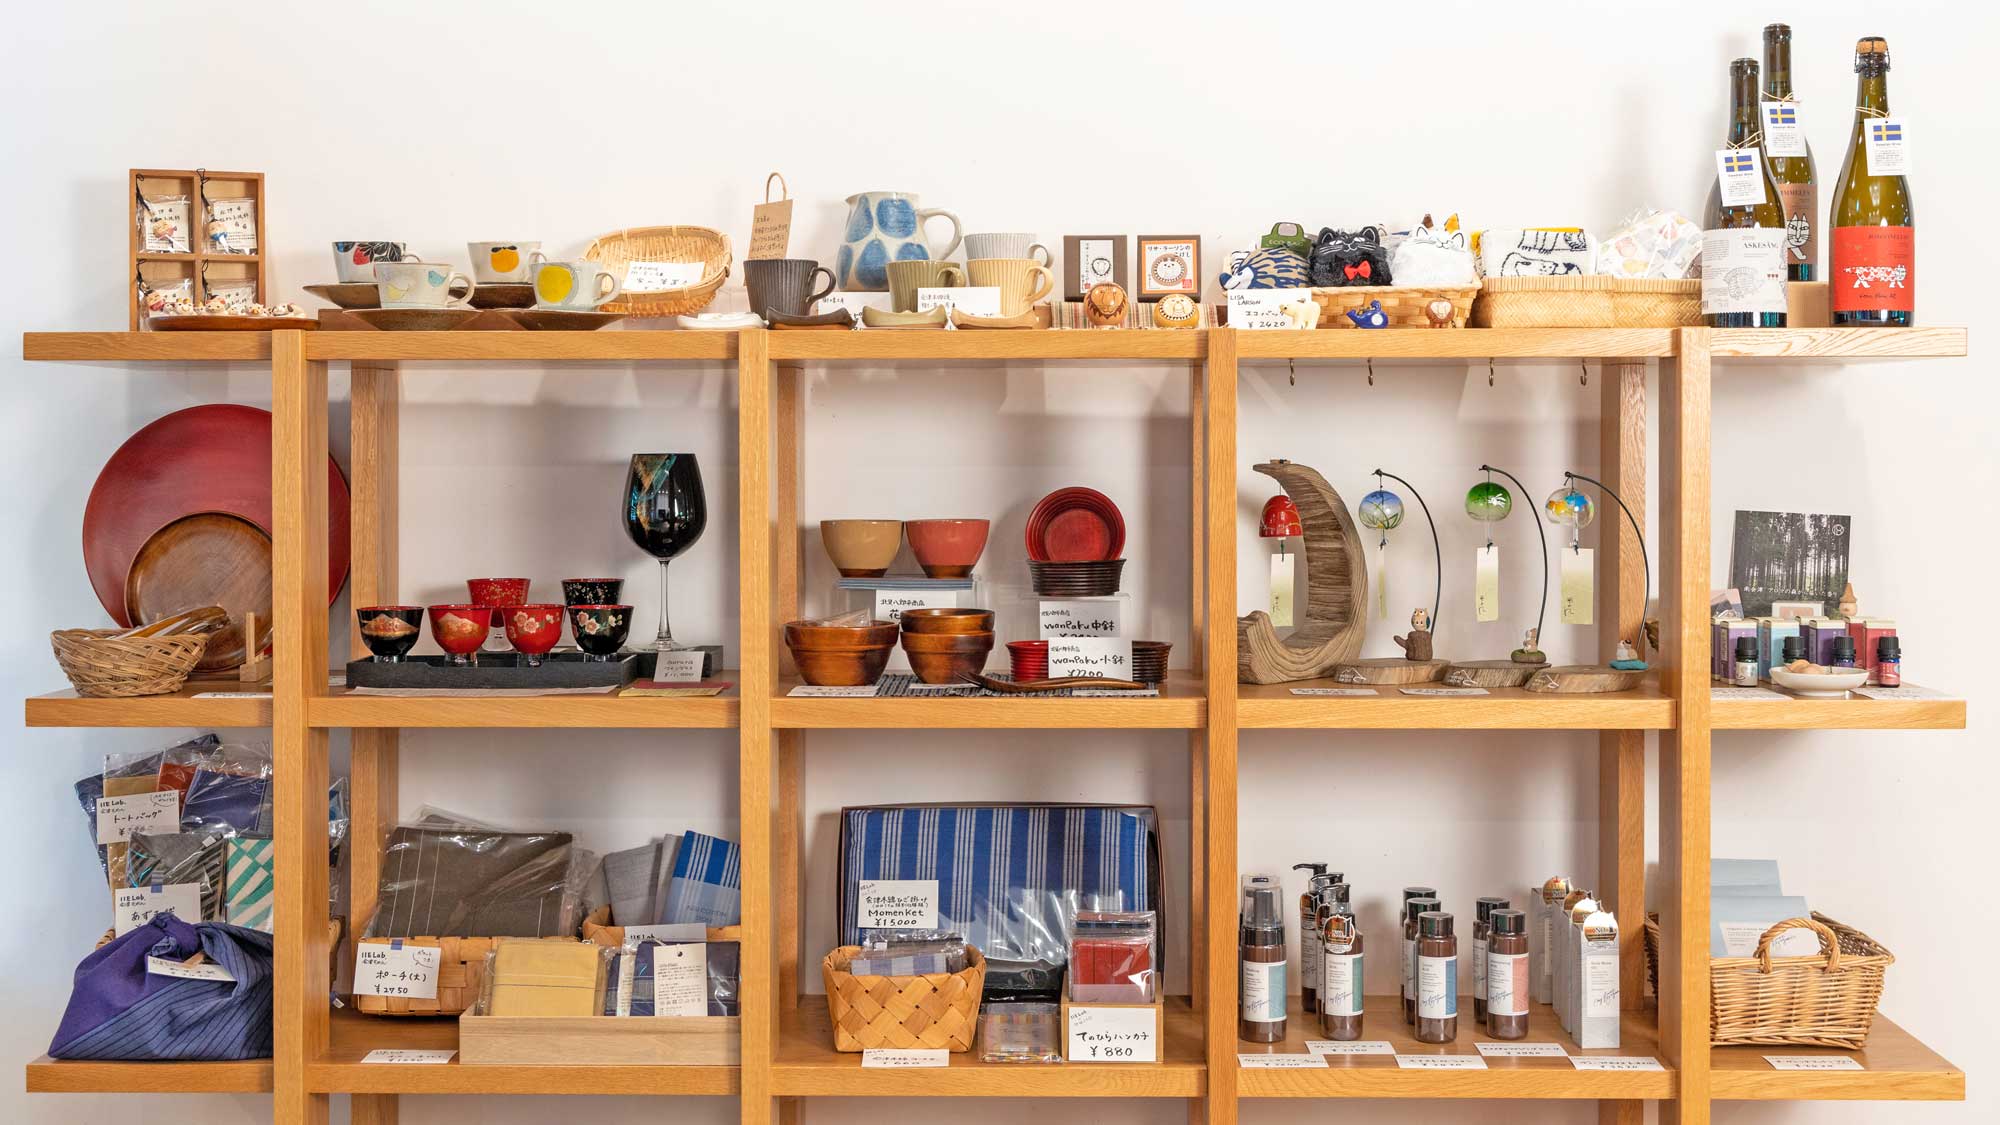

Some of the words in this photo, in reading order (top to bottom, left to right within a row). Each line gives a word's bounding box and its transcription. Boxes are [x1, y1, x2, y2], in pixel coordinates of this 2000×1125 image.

[1075, 1031, 1149, 1042] てのひらハンカチ
